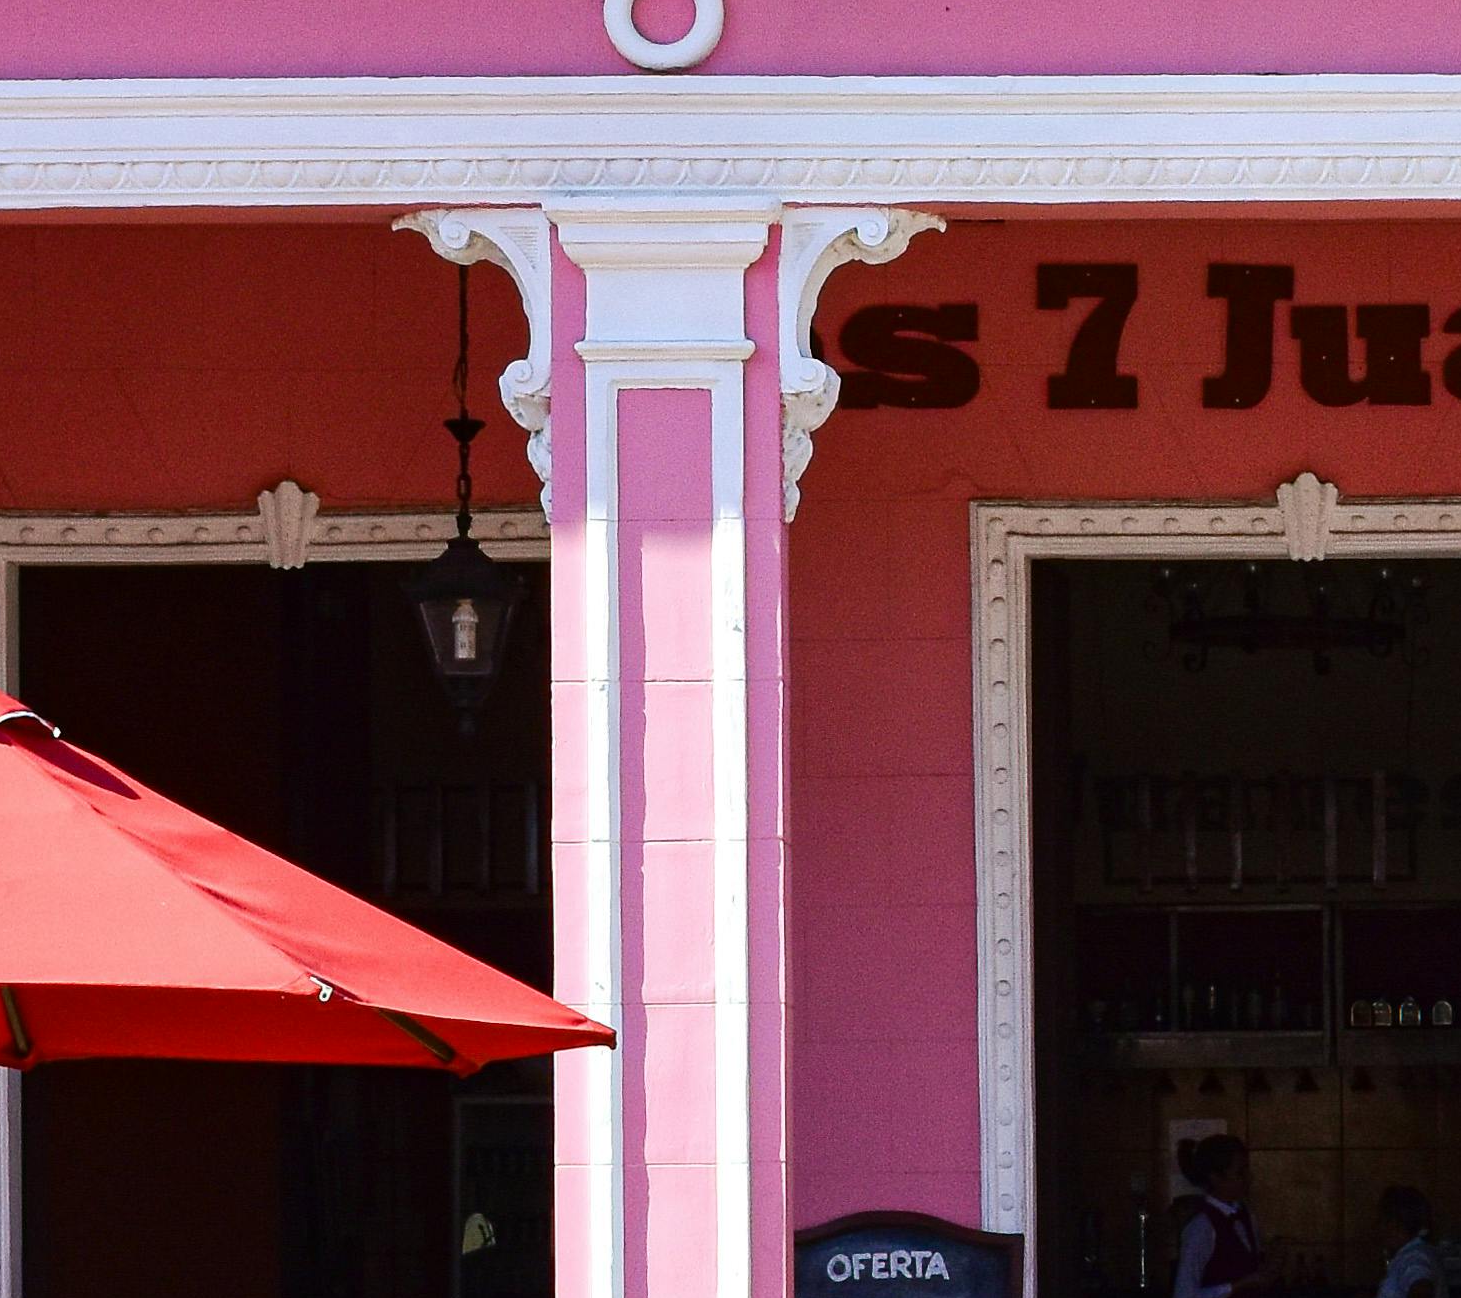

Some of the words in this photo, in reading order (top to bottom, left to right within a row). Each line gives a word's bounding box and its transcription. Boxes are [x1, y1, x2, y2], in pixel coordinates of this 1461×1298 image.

[810, 304, 981, 410] s
[1036, 263, 1139, 410] 7
[826, 1249, 951, 1282] OFERTA
